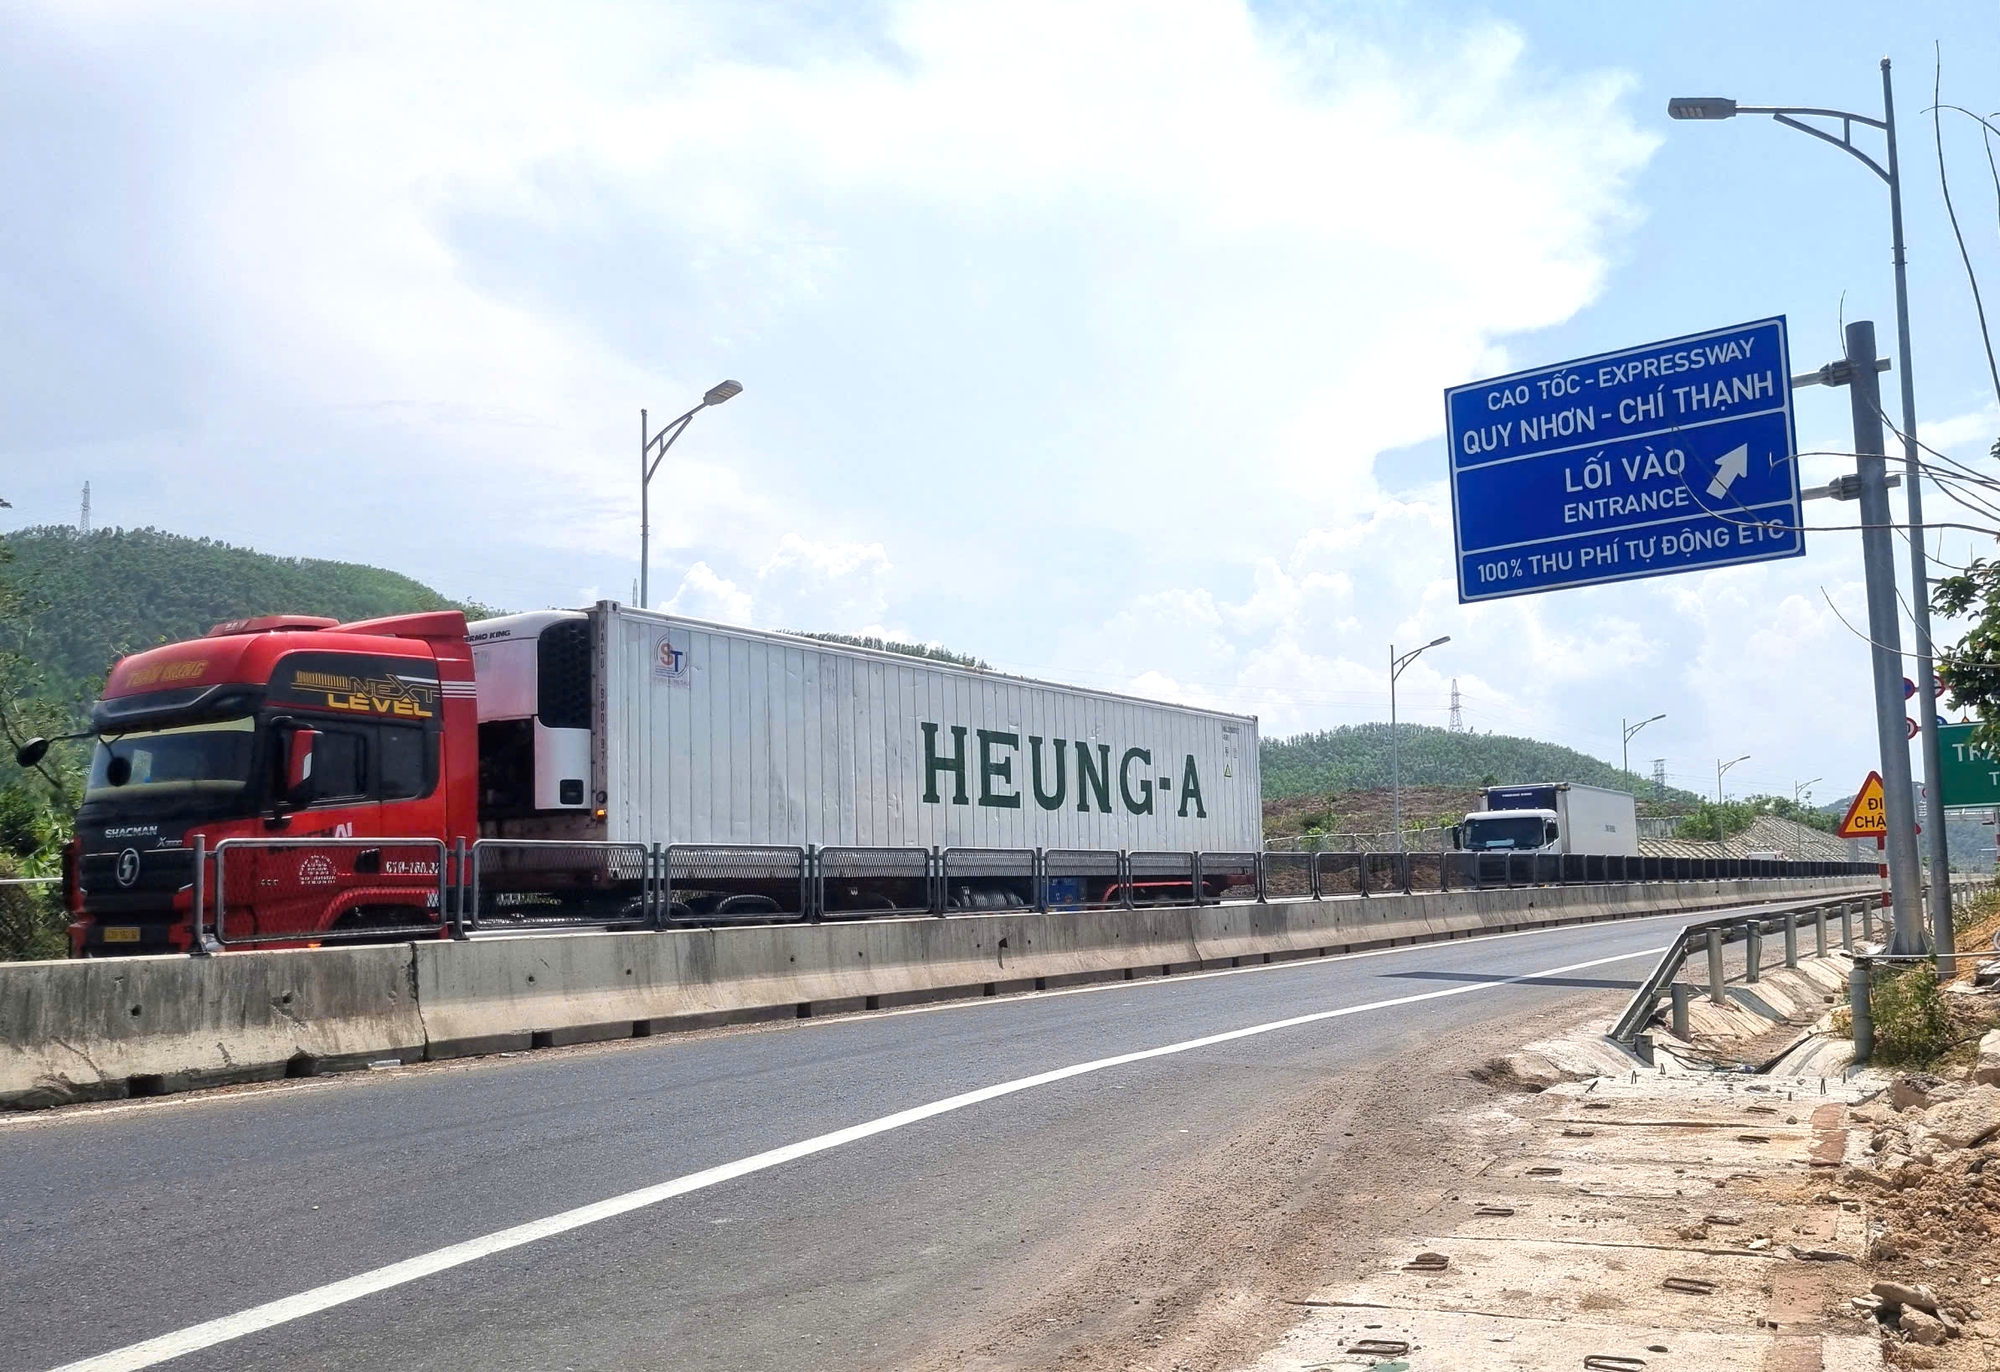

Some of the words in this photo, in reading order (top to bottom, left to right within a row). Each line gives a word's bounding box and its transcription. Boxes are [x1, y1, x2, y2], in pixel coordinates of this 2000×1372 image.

[1487, 385, 1530, 411] CAO
[1536, 369, 1581, 400] TỐC
[1598, 337, 1755, 388] EXPRESSWAY
[1463, 421, 1513, 455] QUY
[1520, 406, 1595, 444] NHƠN
[1618, 383, 1665, 425] CHÍ
[1672, 370, 1774, 414] THẠNH
[1564, 451, 1612, 493] LỐI
[1621, 445, 1686, 482] VÀO
[1563, 486, 1690, 524] ENTRANCE
[1477, 557, 1523, 583] 100%
[1527, 550, 1573, 575] THU
[1580, 537, 1620, 568] PHÍ
[1624, 536, 1657, 563] TỰ
[1661, 527, 1730, 558] ĐỘNG
[1737, 518, 1785, 545] ETC
[489, 629, 511, 640] KING
[327, 693, 433, 717] LEVEL
[349, 673, 440, 703] NEXT
[920, 721, 1208, 819] HEUNG-A
[1854, 812, 1887, 830] CHẬ
[1867, 797, 1883, 811] ĐI
[104, 825, 158, 839] SHACMAN
